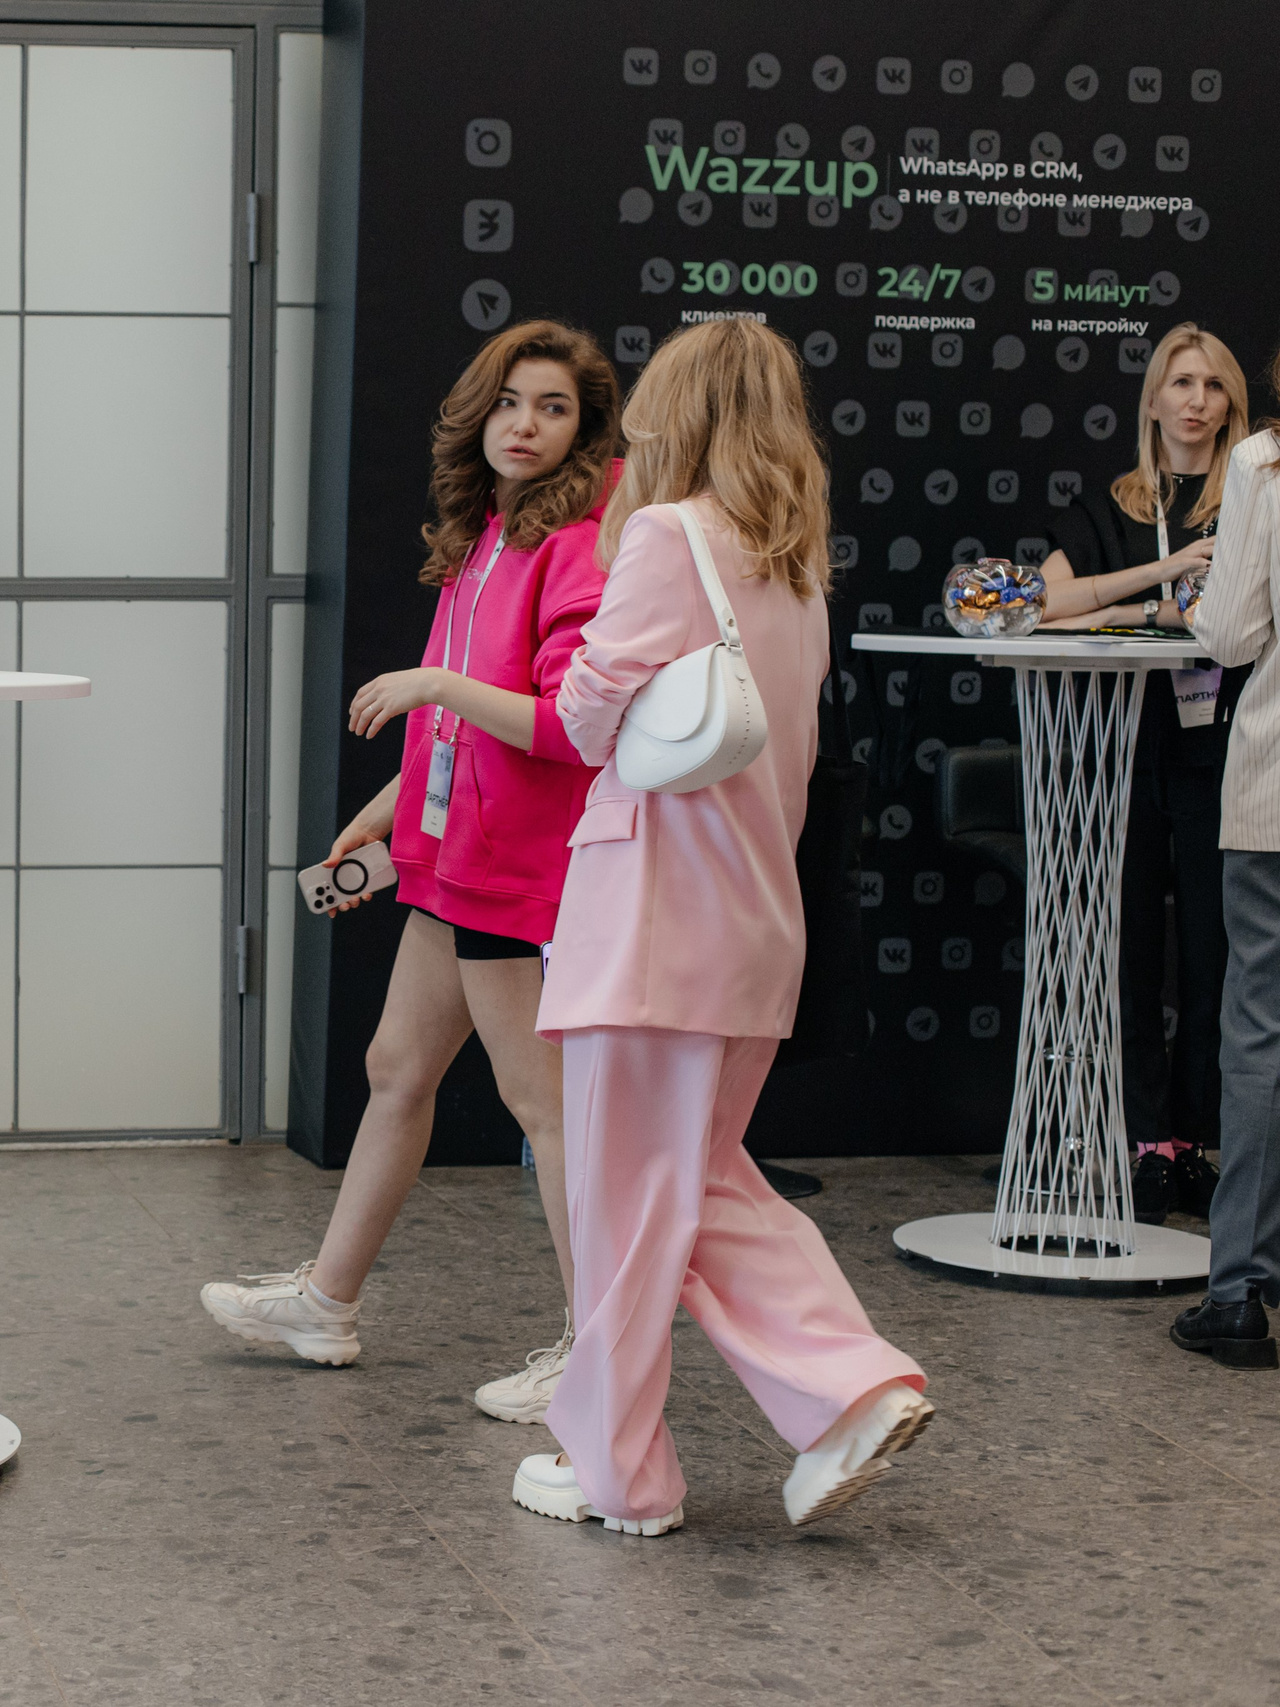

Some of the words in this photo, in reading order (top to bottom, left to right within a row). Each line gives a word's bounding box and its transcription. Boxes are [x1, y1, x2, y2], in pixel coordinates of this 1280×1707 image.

[644, 144, 879, 209] Wazzup
[899, 156, 1008, 181] WhatsApp
[1012, 163, 1026, 178] в
[1030, 161, 1083, 183] CRM,
[897, 189, 910, 203] а
[916, 189, 942, 204] не
[947, 190, 960, 204] в
[965, 188, 1067, 211] телефоне
[1073, 194, 1193, 215] менеджера
[681, 261, 730, 295] 30
[742, 262, 818, 298] 000
[876, 263, 962, 303] 24/7
[1032, 270, 1055, 301] 5
[1063, 282, 1151, 308] минут
[874, 314, 976, 333] поддержка
[1031, 319, 1053, 332] на
[1057, 318, 1149, 336] настройку
